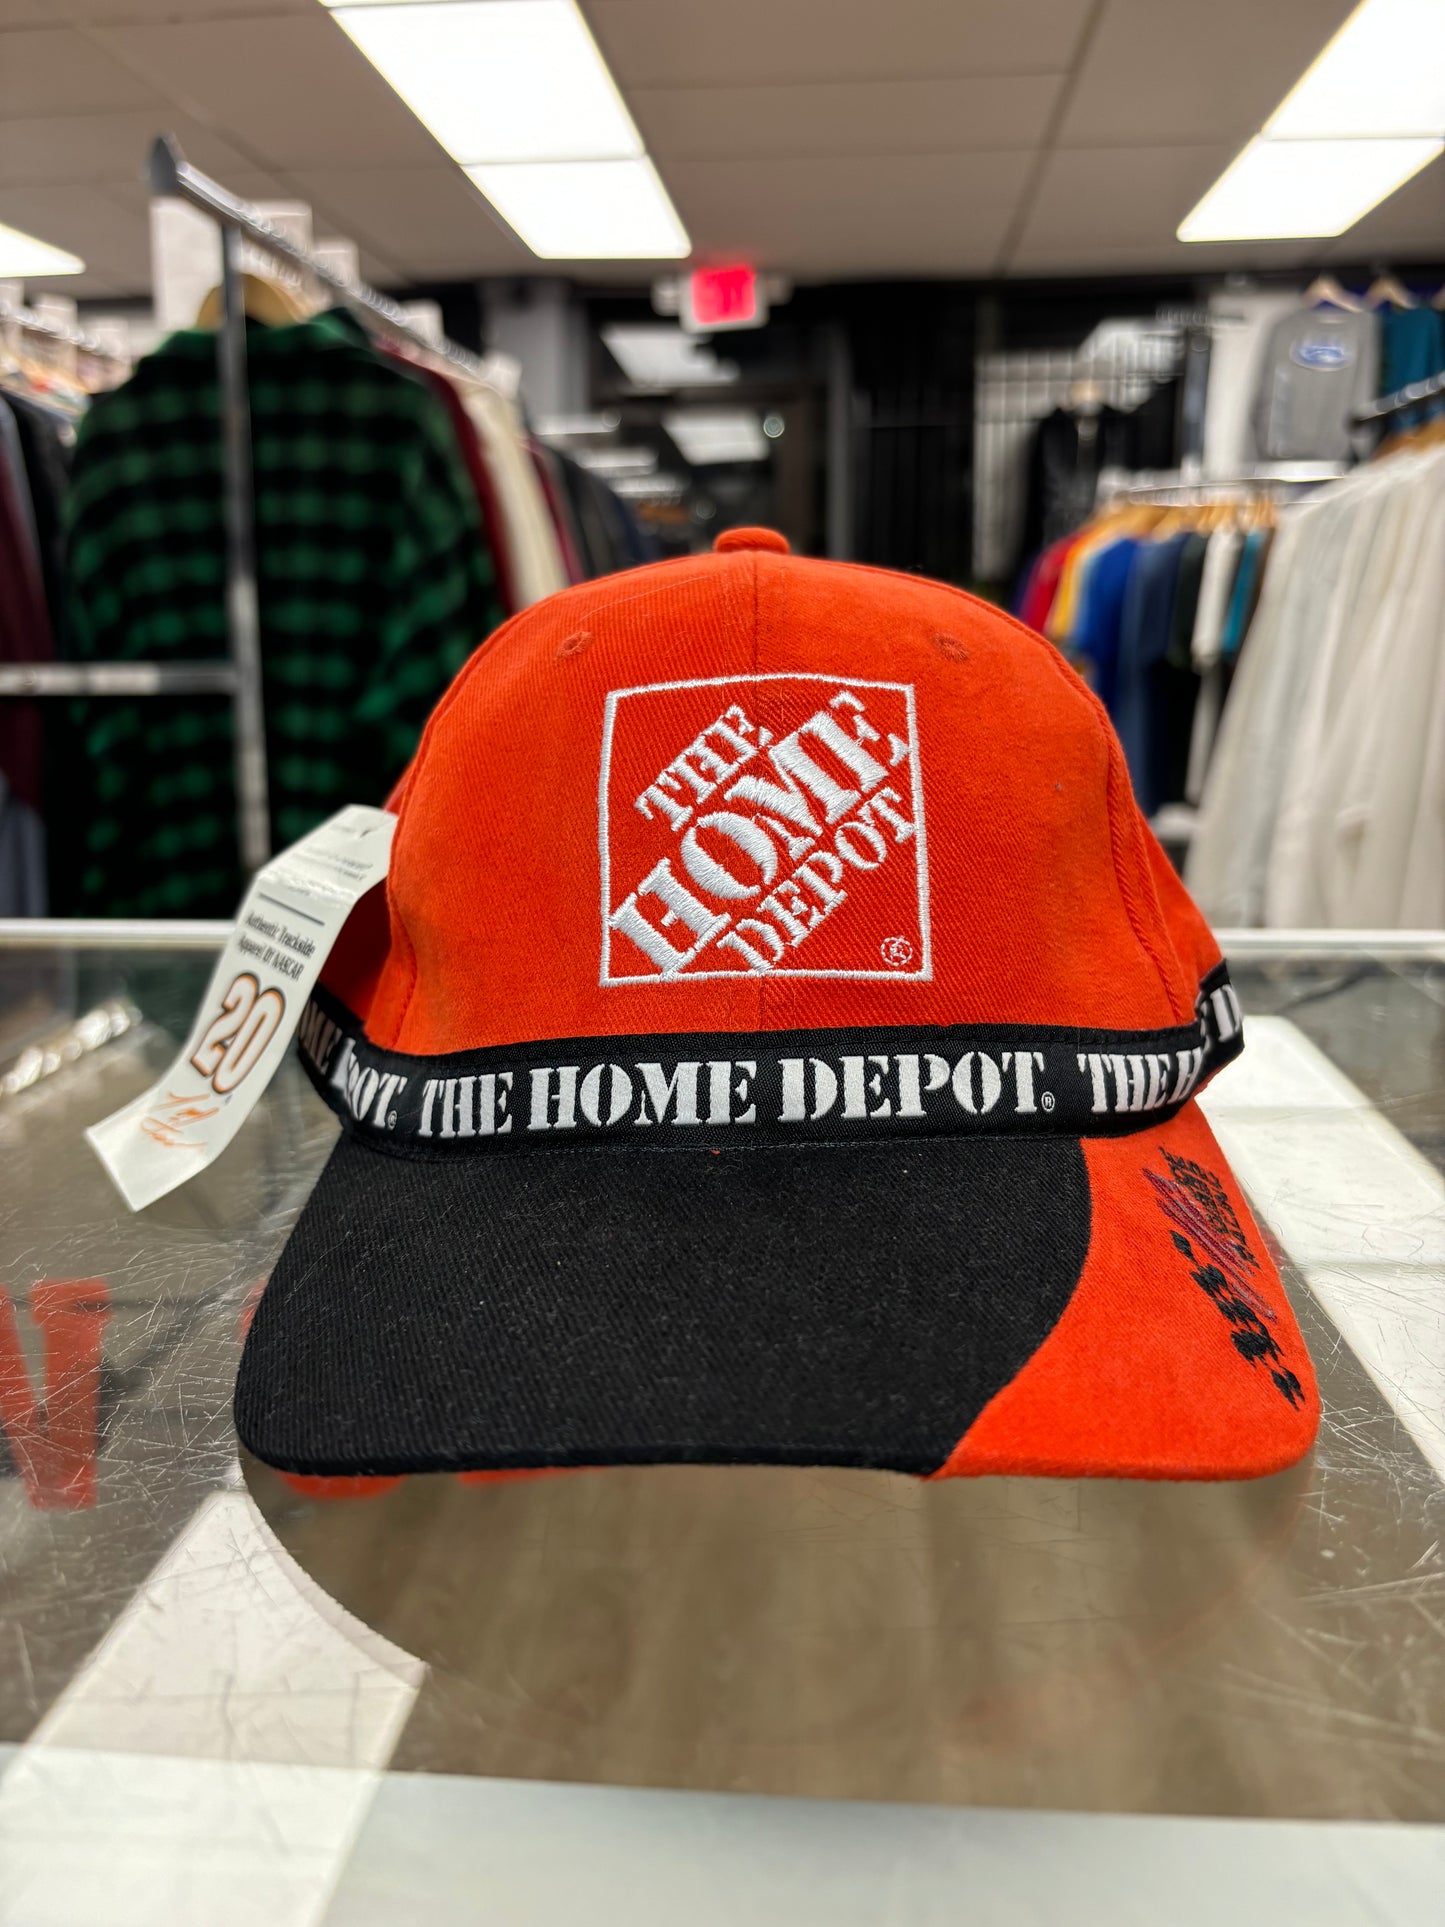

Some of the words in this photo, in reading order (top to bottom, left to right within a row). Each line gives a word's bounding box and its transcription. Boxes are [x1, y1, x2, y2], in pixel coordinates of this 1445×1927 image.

[635, 704, 773, 832] THE
[608, 691, 910, 980] HOME
[716, 787, 917, 977] DEPOT
[191, 972, 286, 1094] 20
[416, 1071, 514, 1139] THE
[527, 1060, 758, 1131] HOME
[1077, 1053, 1170, 1113] THE
